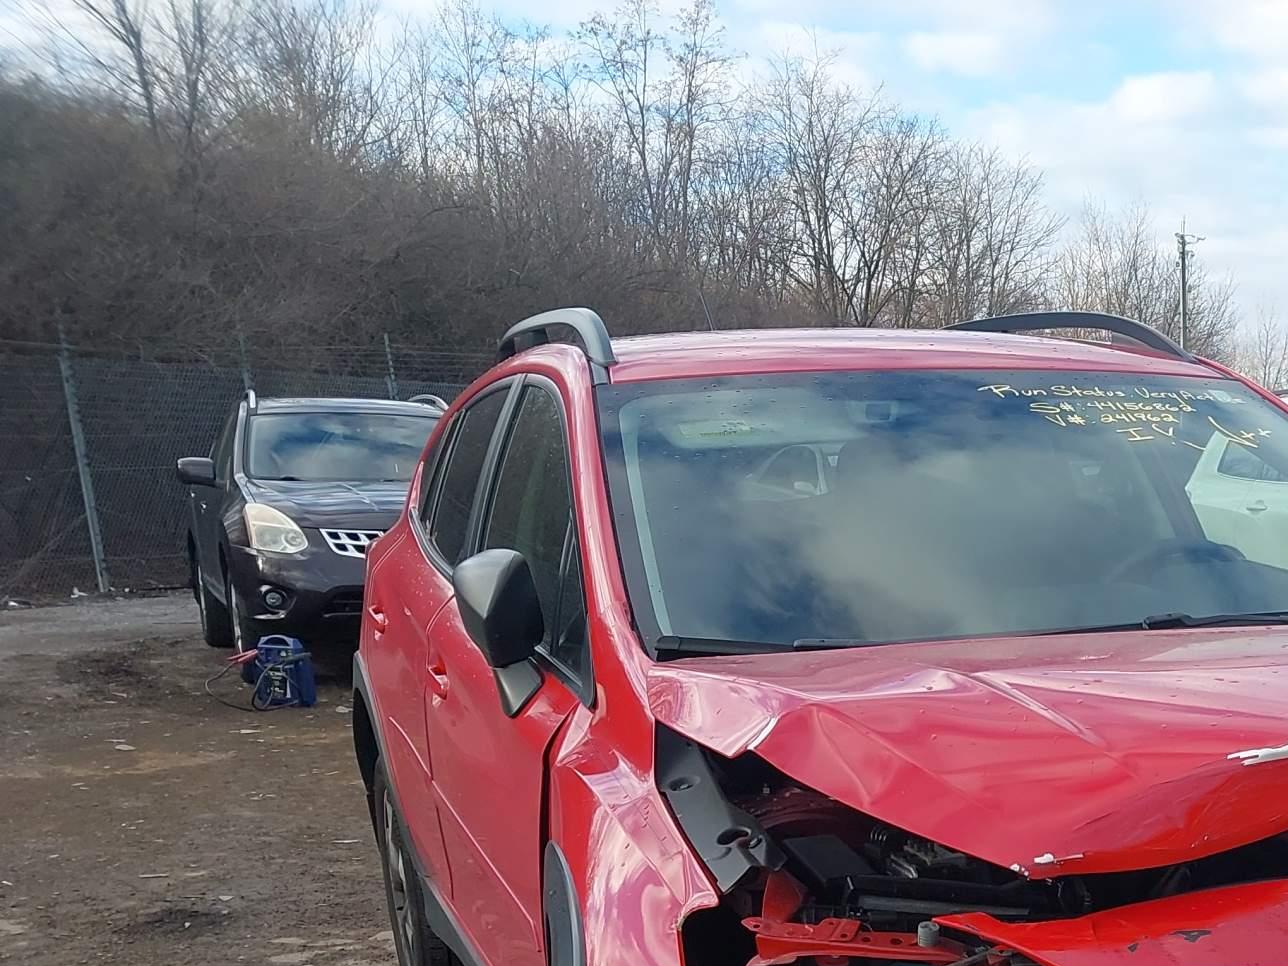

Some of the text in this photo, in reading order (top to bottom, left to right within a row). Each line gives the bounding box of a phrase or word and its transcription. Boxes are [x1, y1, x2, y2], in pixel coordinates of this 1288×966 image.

[977, 384, 1047, 398] Run
[1087, 401, 1197, 412] 44156862
[1100, 413, 1180, 424] 241962
